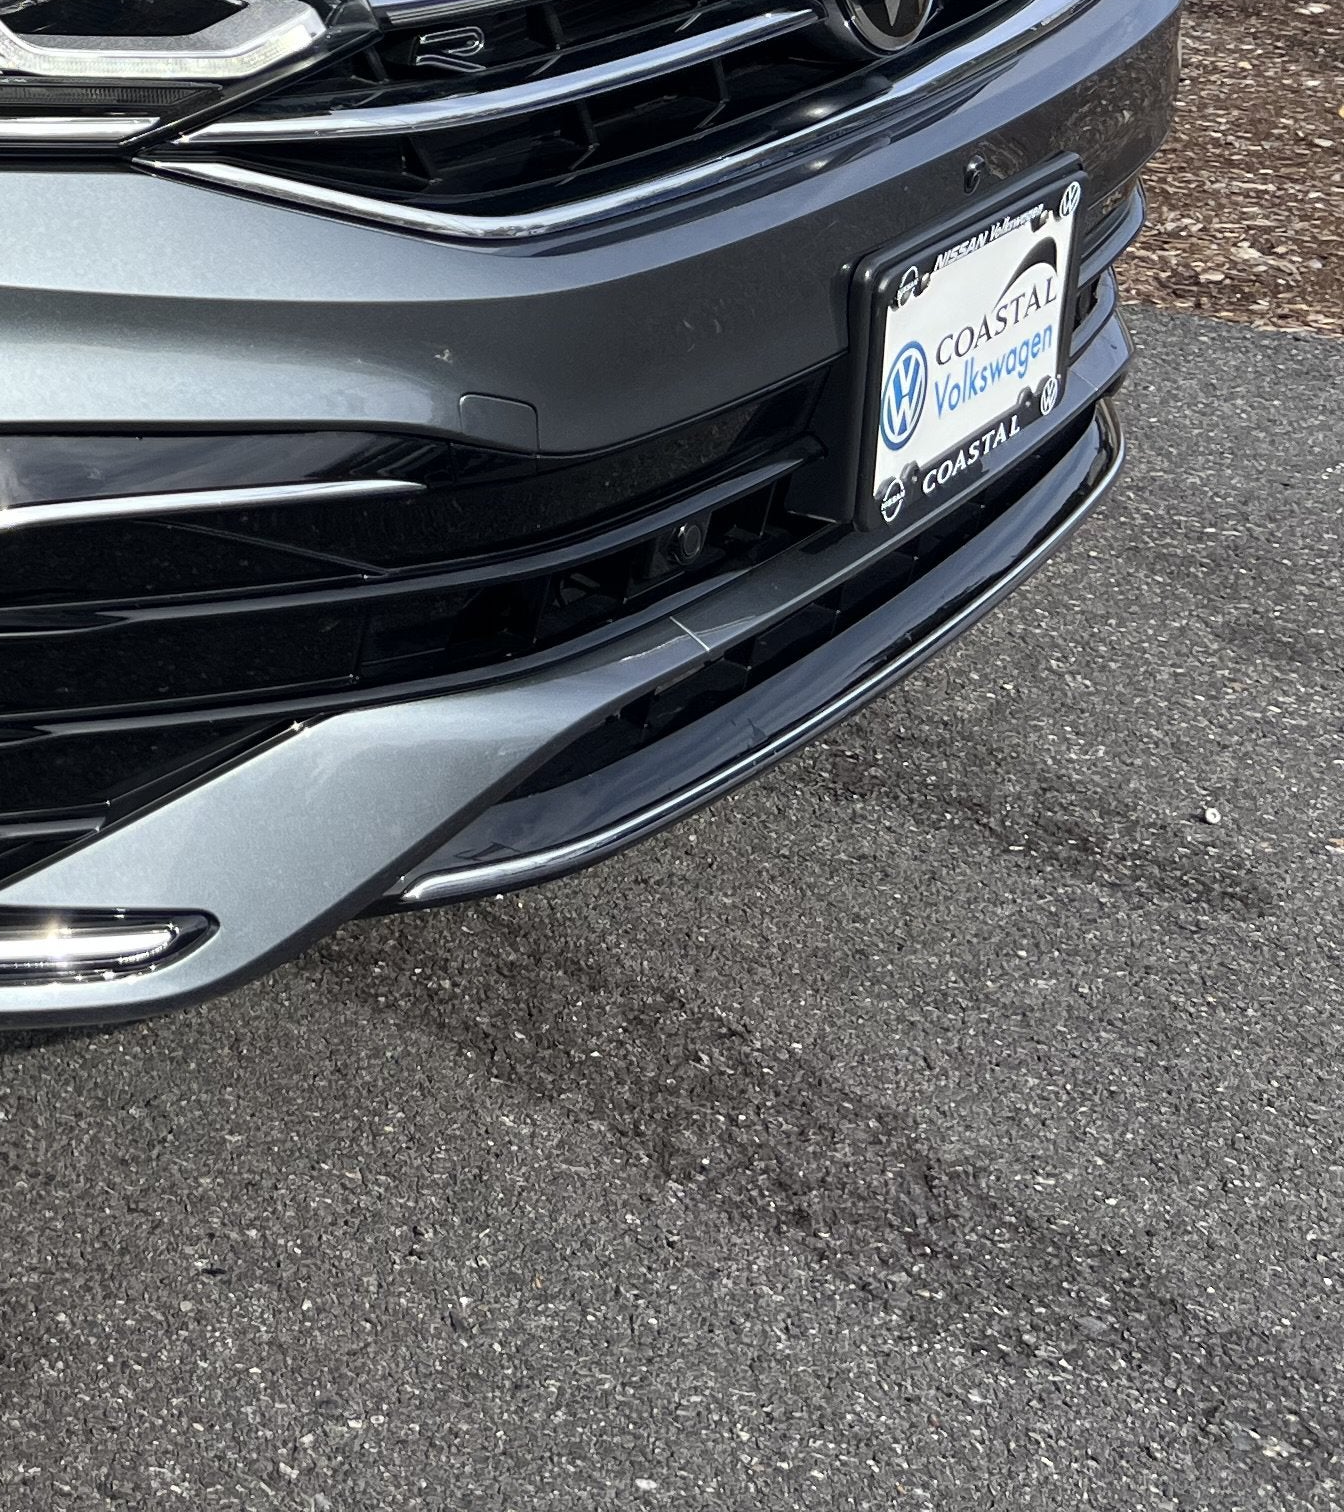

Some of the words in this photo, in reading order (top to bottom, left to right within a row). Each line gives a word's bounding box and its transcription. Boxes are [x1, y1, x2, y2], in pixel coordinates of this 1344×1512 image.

[415, 26, 486, 73] R
[933, 231, 989, 271] NISSAN
[935, 276, 1058, 367] COASTAL
[934, 324, 1053, 420] Volkswagen
[922, 415, 1021, 494] COASTAL
